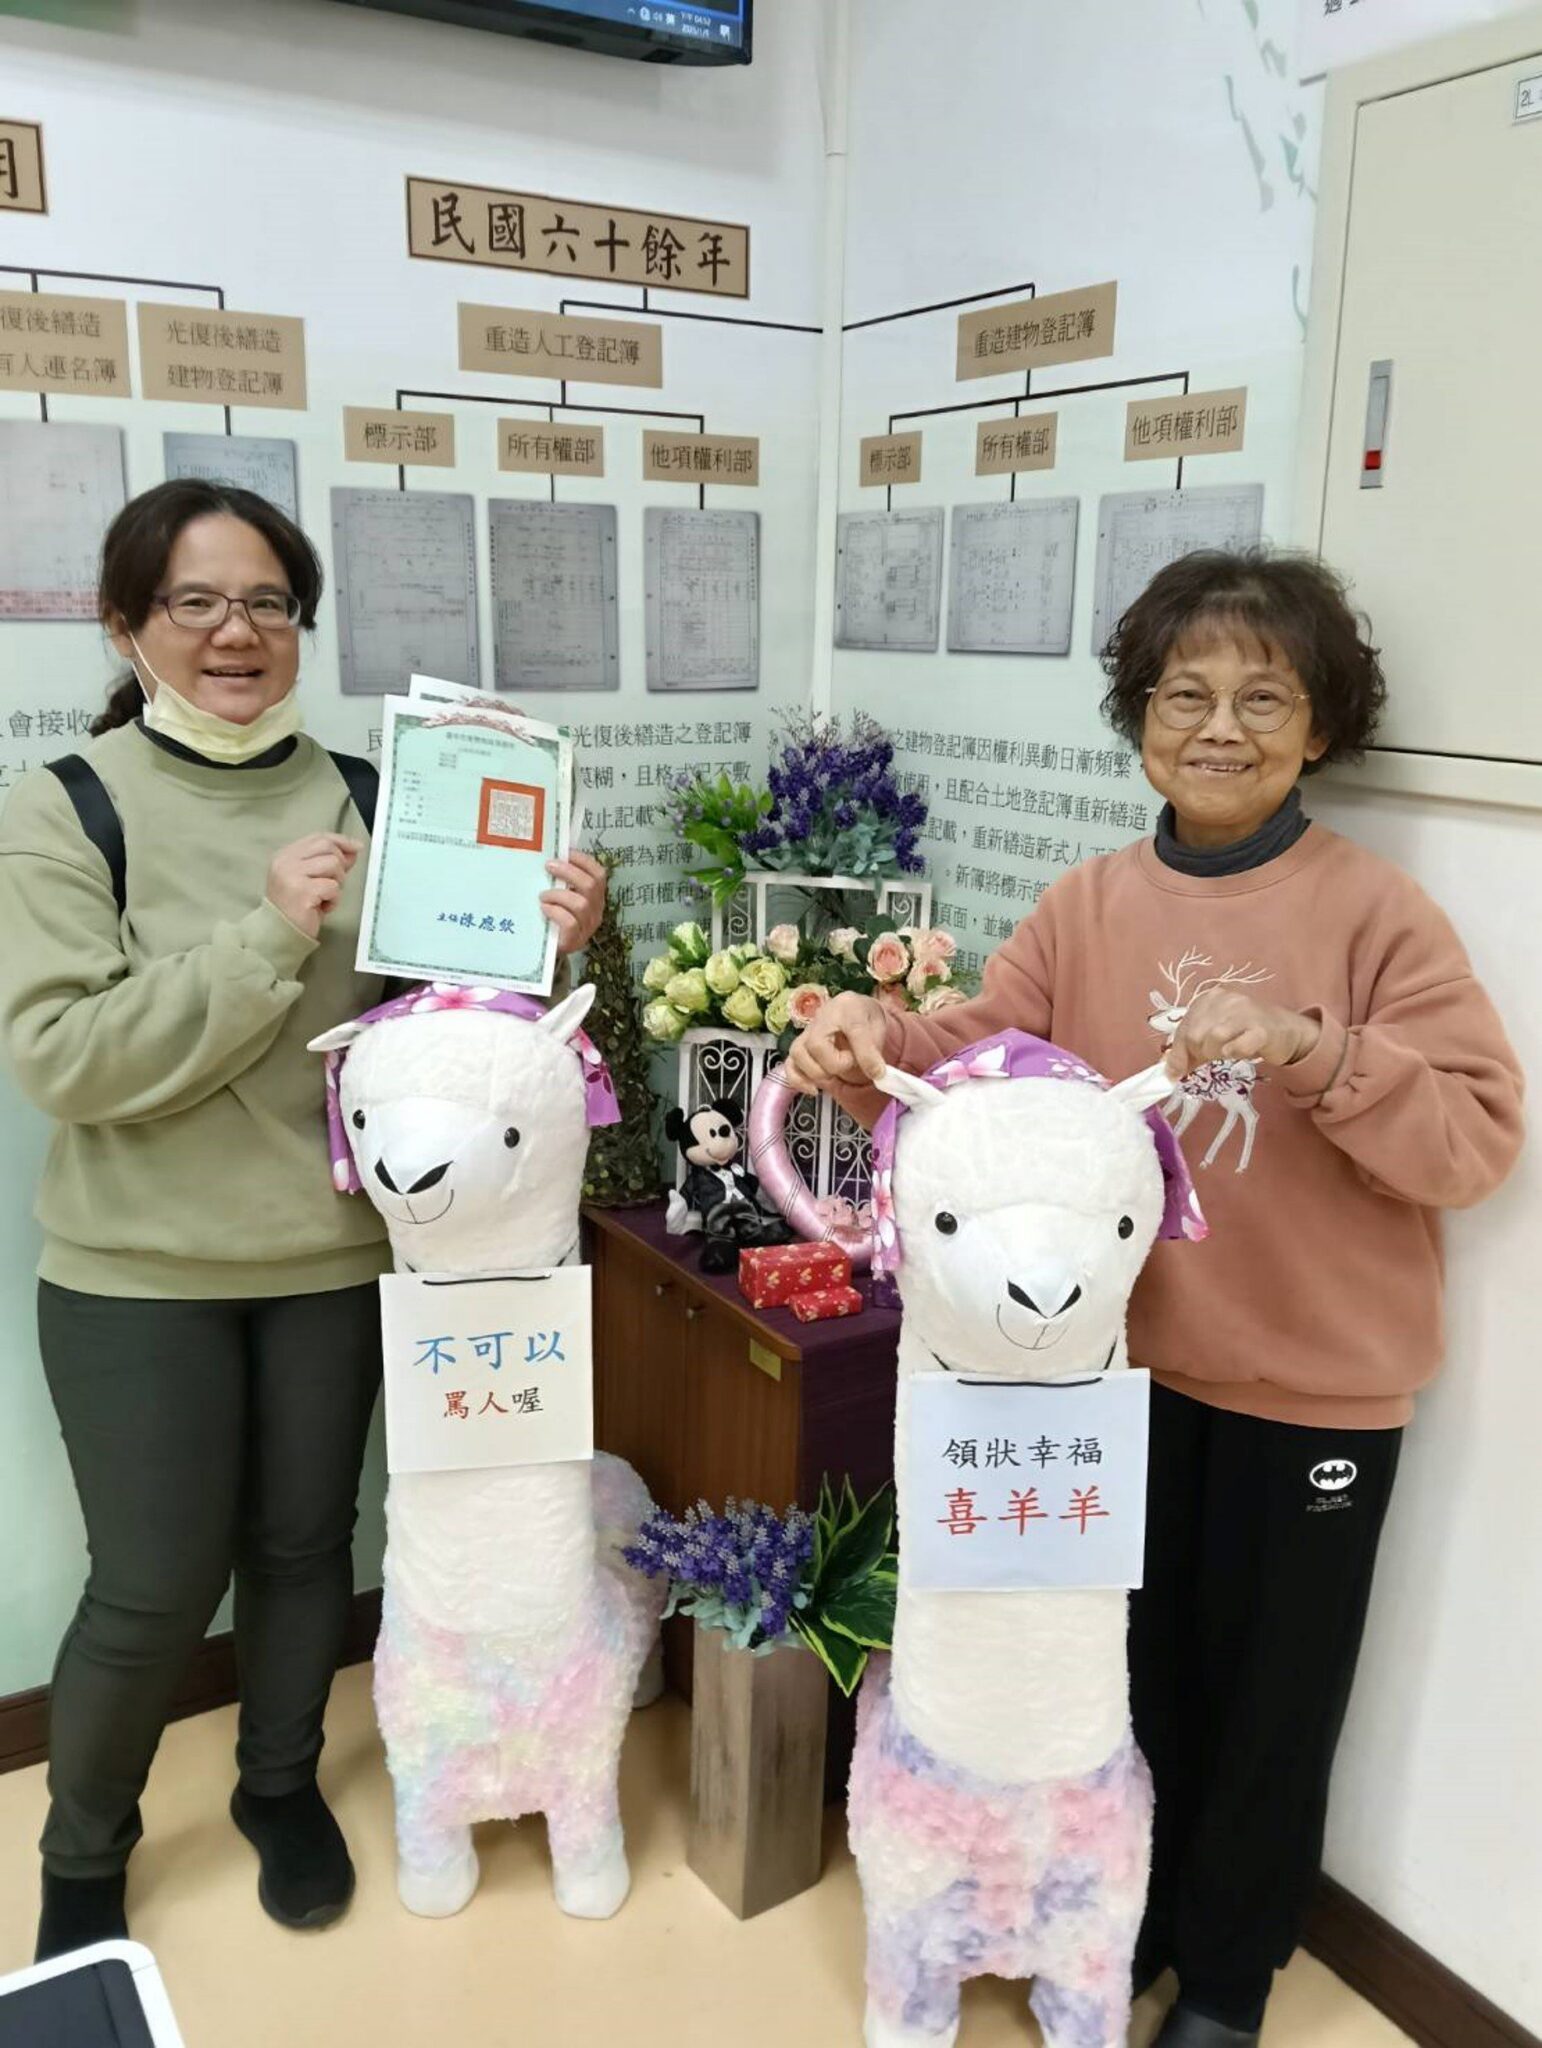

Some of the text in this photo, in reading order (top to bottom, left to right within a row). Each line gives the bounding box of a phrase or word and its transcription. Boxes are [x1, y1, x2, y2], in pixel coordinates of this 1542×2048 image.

[431, 193, 730, 286] 民國六十餘年
[167, 318, 282, 354] 光復後繕造
[484, 325, 640, 366] 重造人工登記簿
[972, 307, 1097, 359] 重造建物登記簿
[167, 363, 285, 396] 建物登記簿
[363, 421, 438, 453] 標示部
[1131, 404, 1239, 447] 他項權利部
[507, 431, 596, 464] 所有權部
[650, 442, 754, 474] 他項權利部
[869, 446, 912, 472] 標示部
[981, 428, 1050, 462] 所有權部
[574, 721, 752, 749] 光復後繕造之登記簿
[413, 1331, 565, 1375] 不可以
[443, 1386, 543, 1420] 罵人喔
[941, 1434, 1103, 1469] 領狀幸福
[936, 1485, 1111, 1537] 喜羊羊
